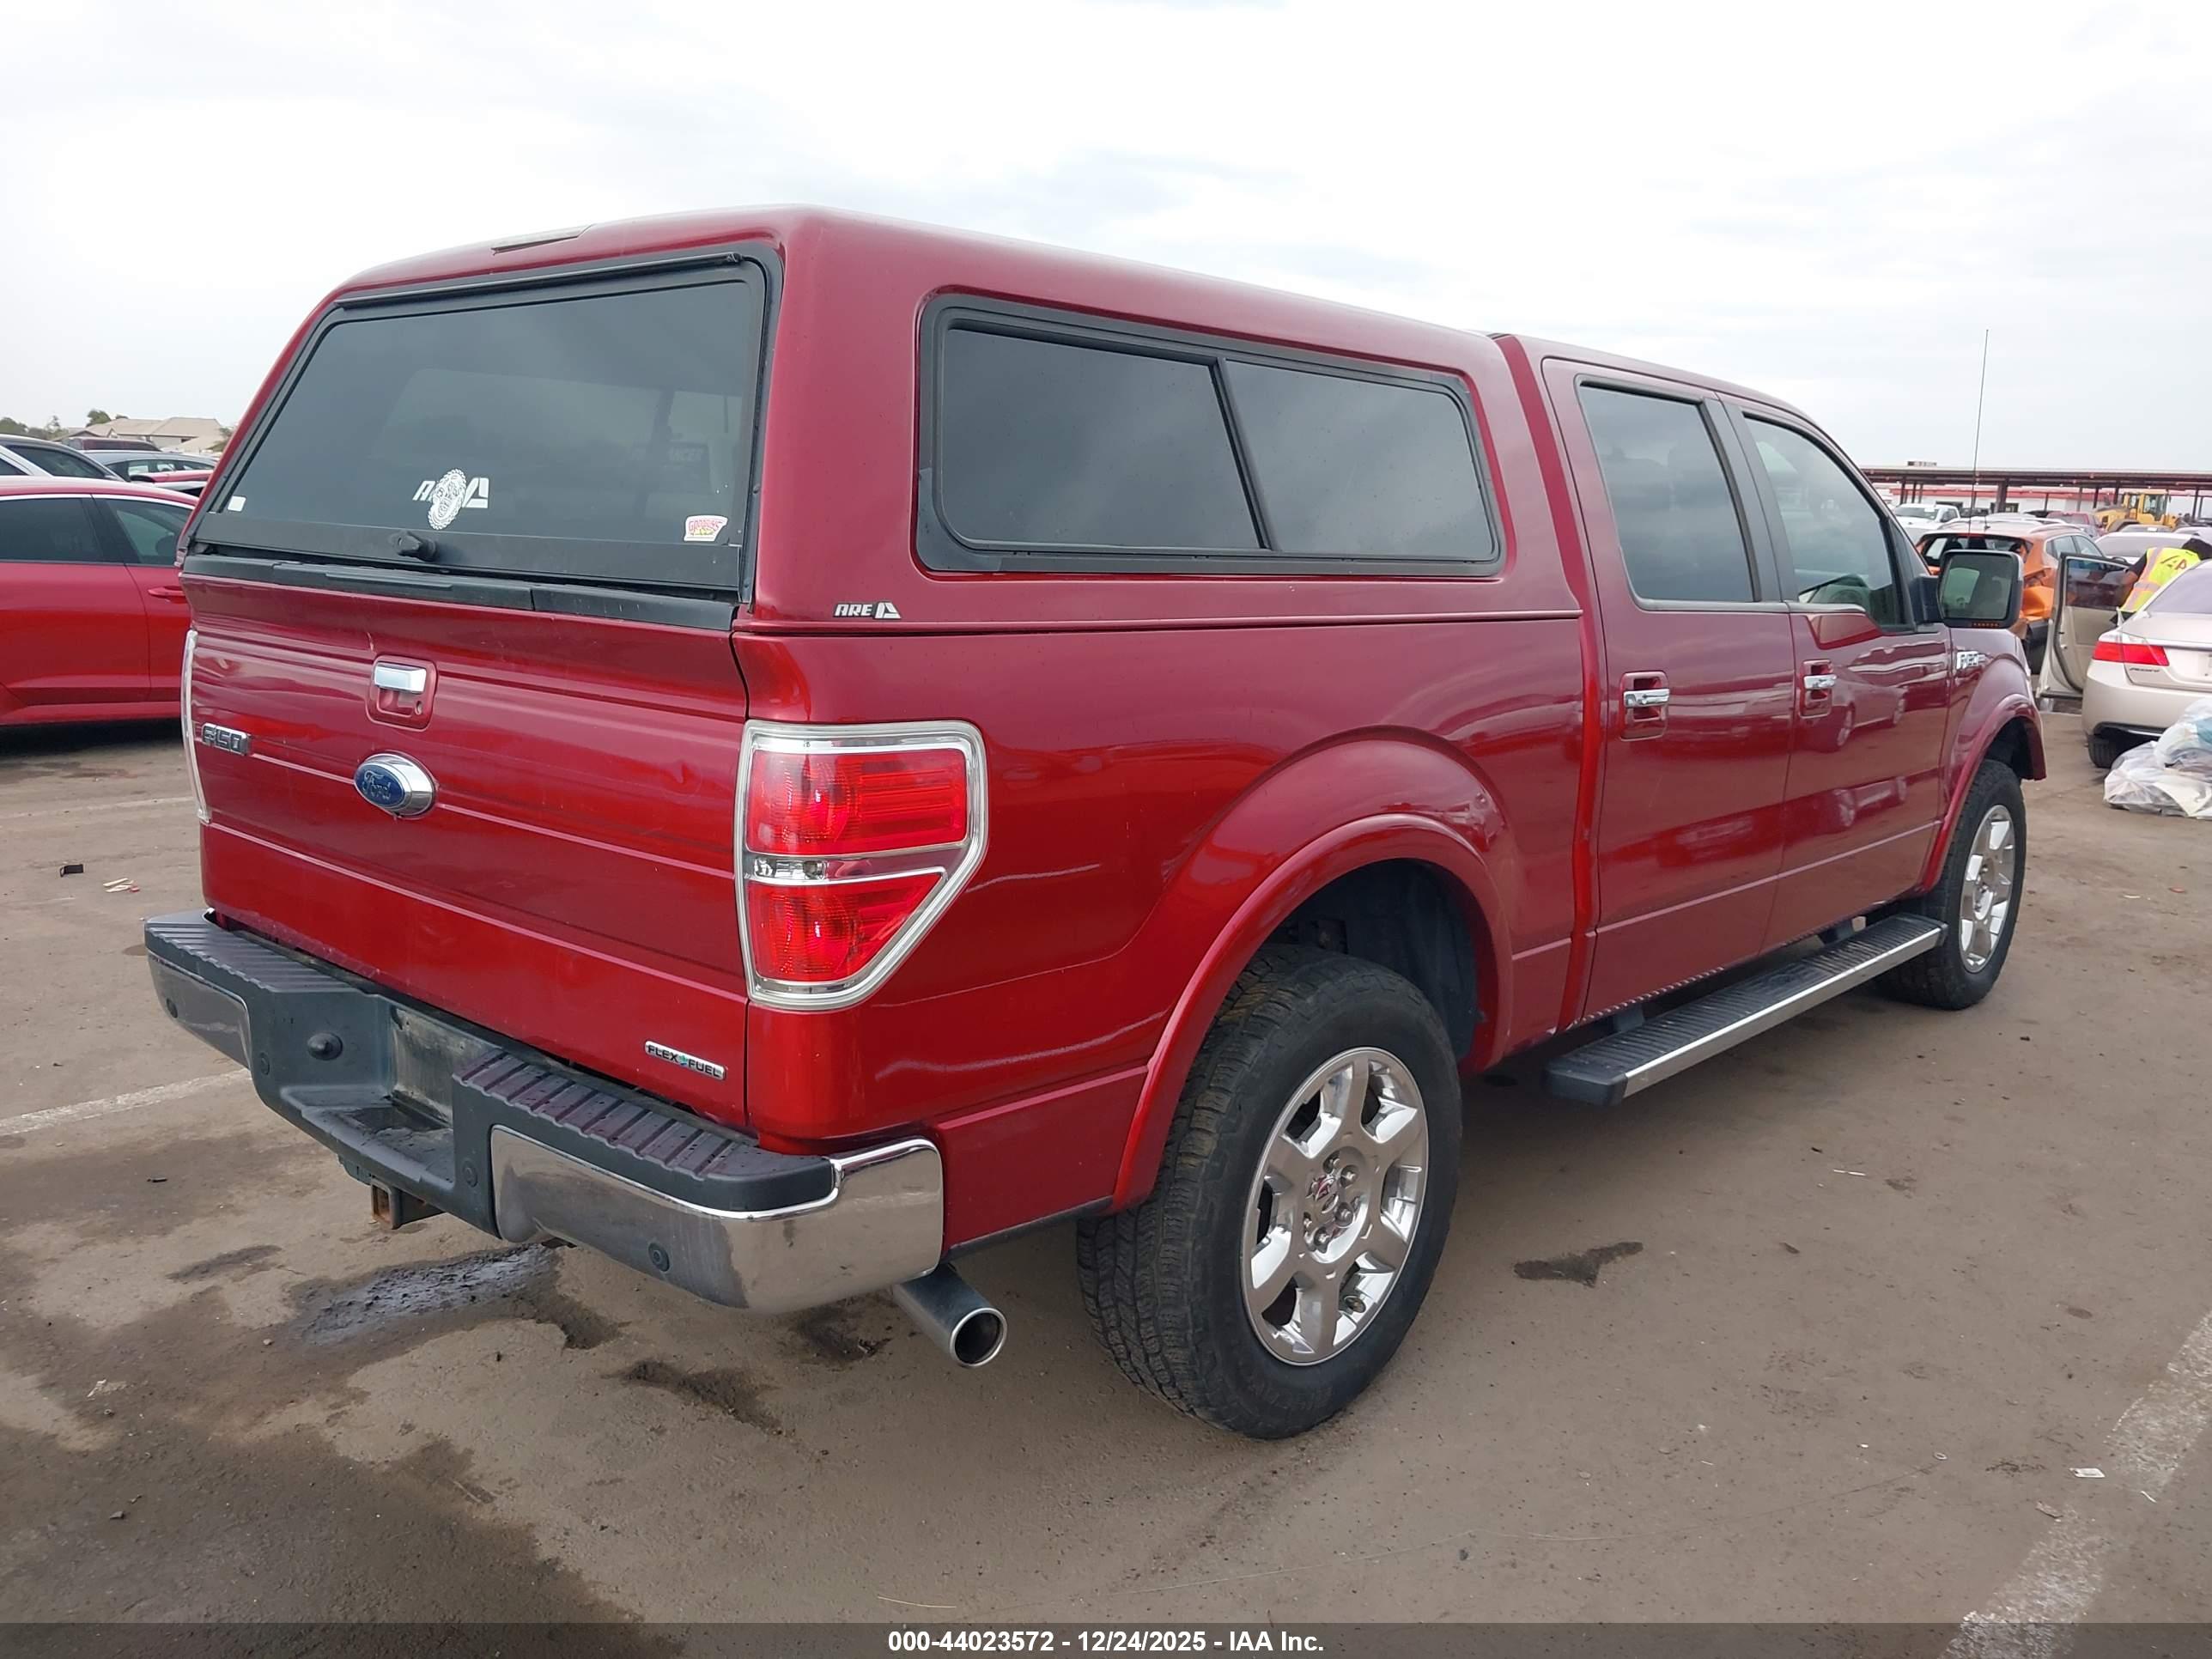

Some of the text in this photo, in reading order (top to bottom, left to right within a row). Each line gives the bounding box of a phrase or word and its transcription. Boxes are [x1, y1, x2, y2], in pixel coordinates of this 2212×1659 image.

[834, 604, 873, 617] ARE
[647, 1044, 721, 1078] FLEX FUEL
